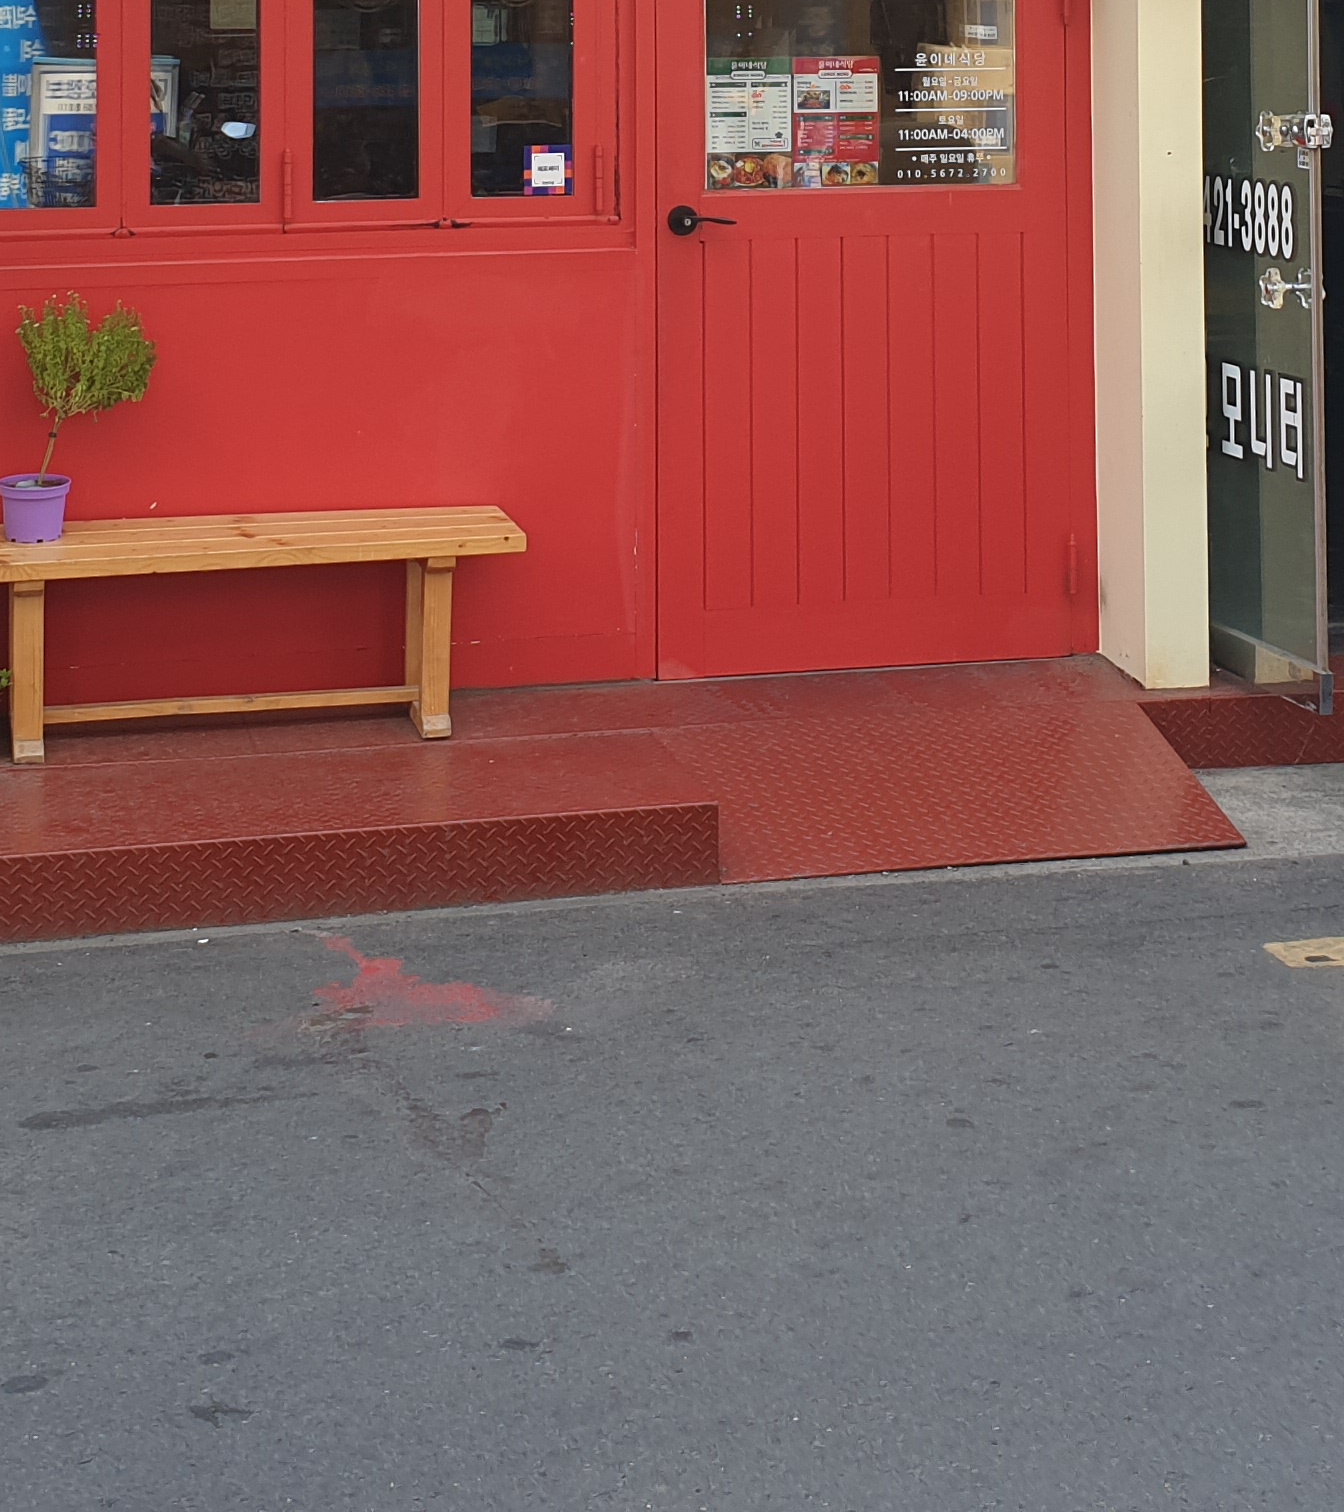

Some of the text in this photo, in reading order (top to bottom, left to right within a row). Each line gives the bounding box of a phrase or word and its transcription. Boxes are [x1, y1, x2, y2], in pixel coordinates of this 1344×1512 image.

[914, 51, 986, 67] 윤이네식당
[938, 115, 964, 125] 토요일
[920, 153, 937, 164] 매주
[939, 153, 964, 164] 일요일
[1221, 361, 1304, 479] 모니터
